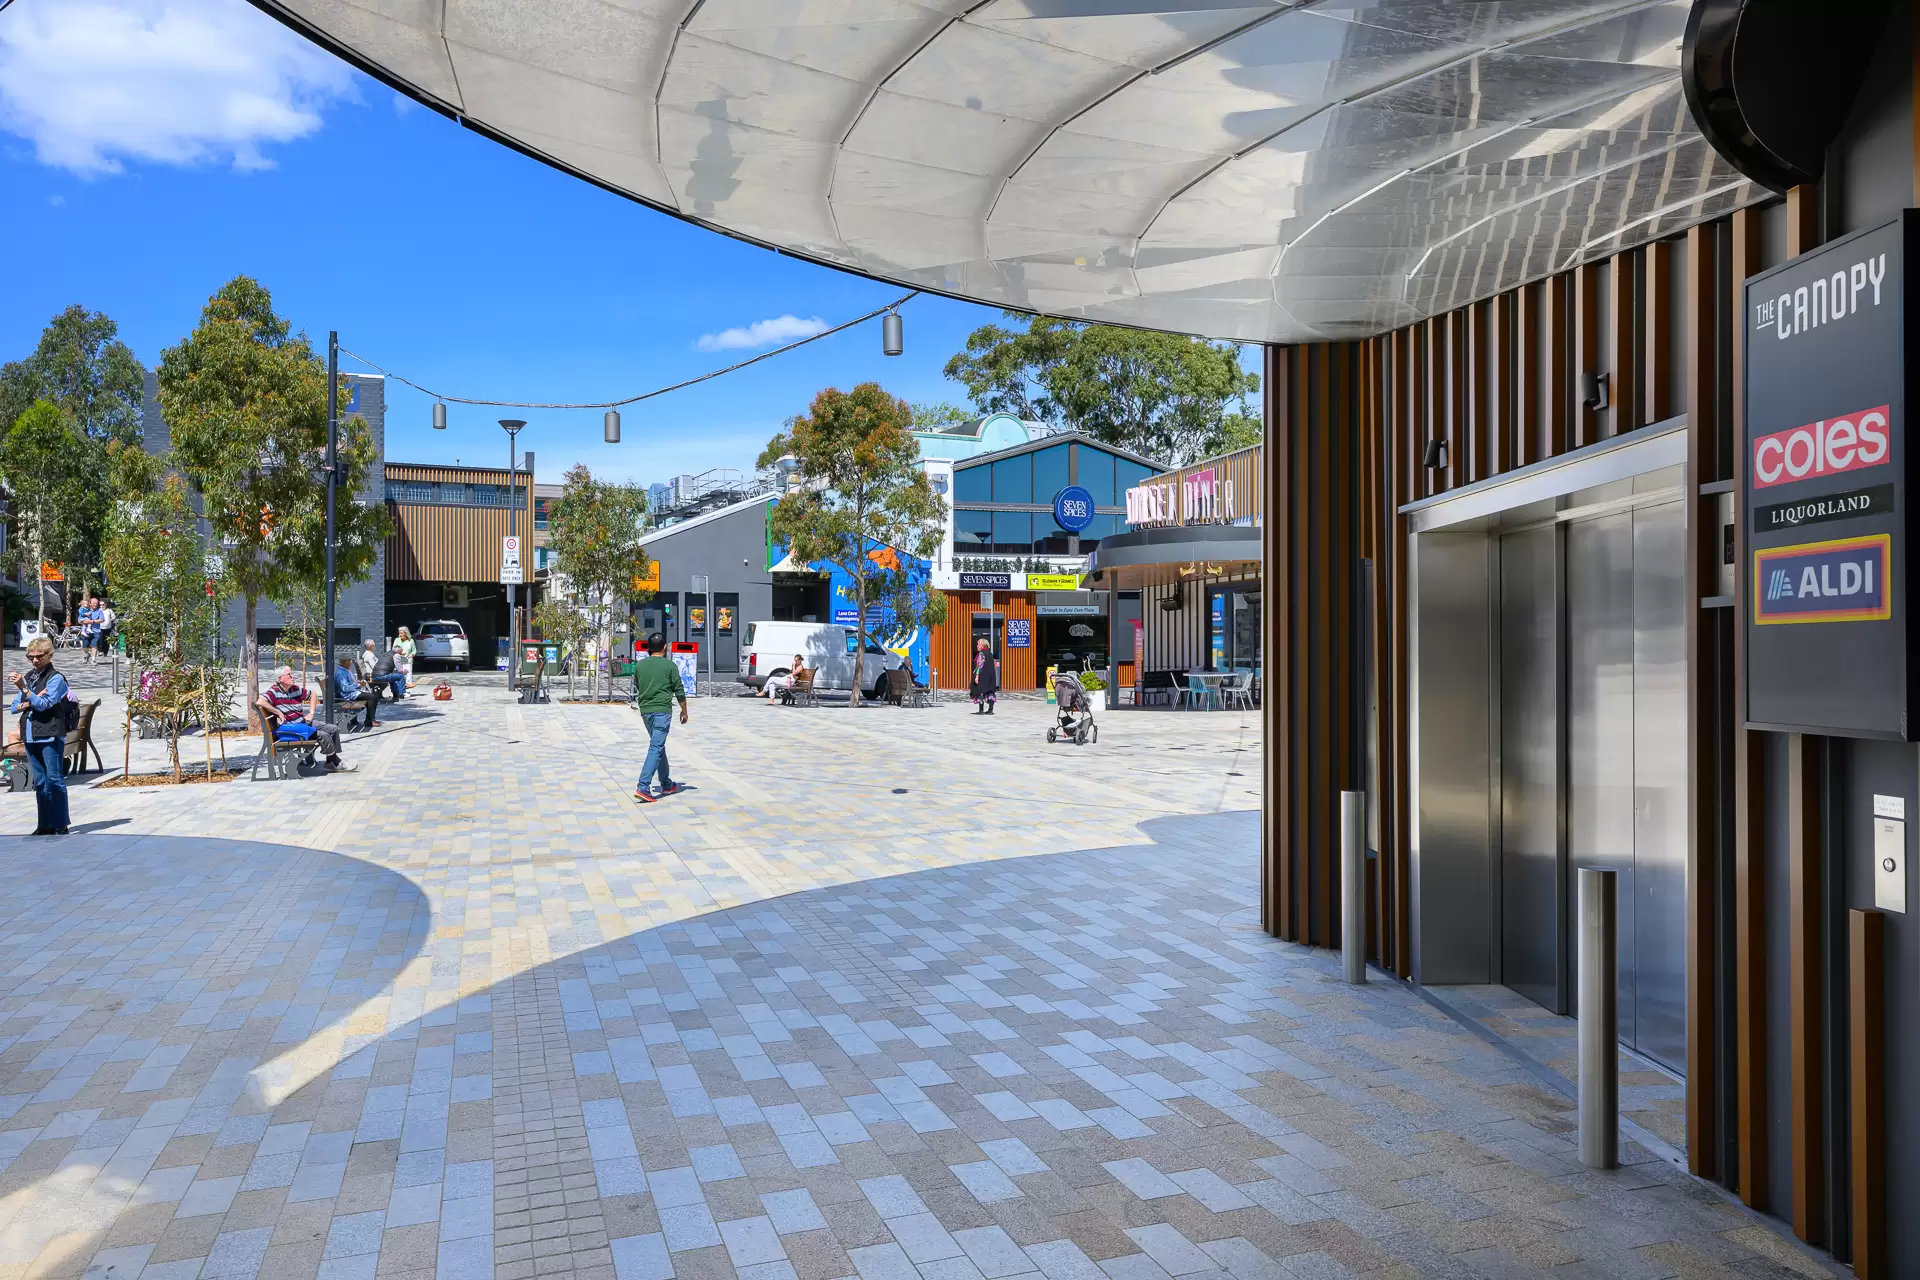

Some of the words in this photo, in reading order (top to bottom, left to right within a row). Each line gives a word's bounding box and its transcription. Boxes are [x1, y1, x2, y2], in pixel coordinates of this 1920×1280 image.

[1756, 299, 1775, 324] THE
[1777, 253, 1886, 340] CANOPY
[1756, 412, 1887, 483] coles
[1063, 500, 1087, 509] SEVEN
[1183, 479, 1235, 523] DINER
[1771, 495, 1871, 524] LIQUORLAND
[1063, 509, 1087, 518] SPICES
[963, 575, 985, 584] SEVEN
[985, 576, 1008, 584] SPICES
[1798, 560, 1874, 599] ALDI
[1008, 620, 1030, 629] SEVEN
[1008, 628, 1030, 636] SPICES
